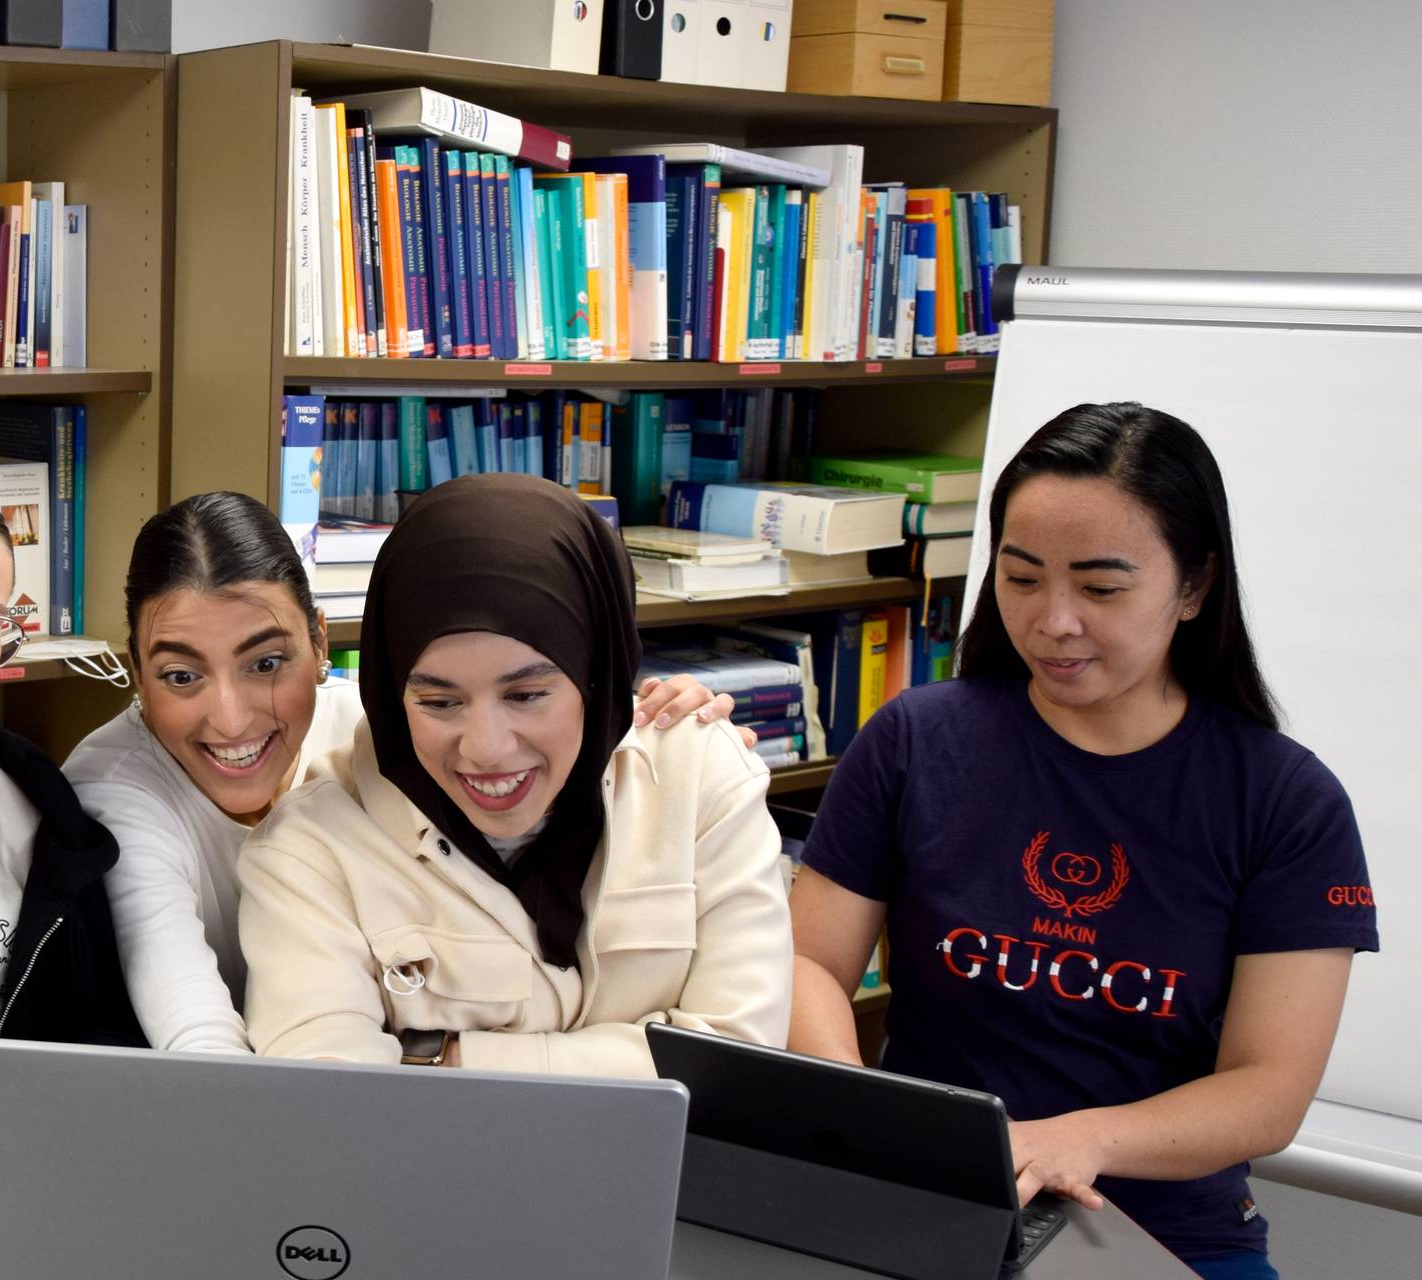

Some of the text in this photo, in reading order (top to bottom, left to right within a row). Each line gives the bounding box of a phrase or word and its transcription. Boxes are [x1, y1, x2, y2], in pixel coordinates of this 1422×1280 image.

[299, 112, 310, 269] Mensch Körper Krankheit
[413, 180, 422, 222] BIOLOGIE
[454, 183, 462, 225] BIOLOGIE
[487, 185, 496, 227] BIOLOGIE
[503, 186, 511, 227] BIOLOGIE
[402, 178, 415, 273] BIOLOGIE ANATOMIE
[435, 191, 443, 234] ANATOMIE
[709, 194, 718, 233] BIOLOGIE
[416, 226, 425, 273] ANATOMIE
[457, 230, 465, 275] ANATOMIE
[475, 230, 484, 276] ANATOMIE
[490, 231, 499, 276] ANATOMIE
[505, 232, 514, 277] ANATOMIE
[706, 238, 715, 282] ANATOMIE
[1026, 277, 1071, 287] MAUL
[298, 415, 317, 425] Pflege
[823, 469, 884, 488] Chirurgie
[7, 604, 39, 617] ORUM
[1032, 916, 1097, 945] MAKIN
[940, 927, 1186, 1018] GUCCI
[284, 1245, 343, 1263] DELL
